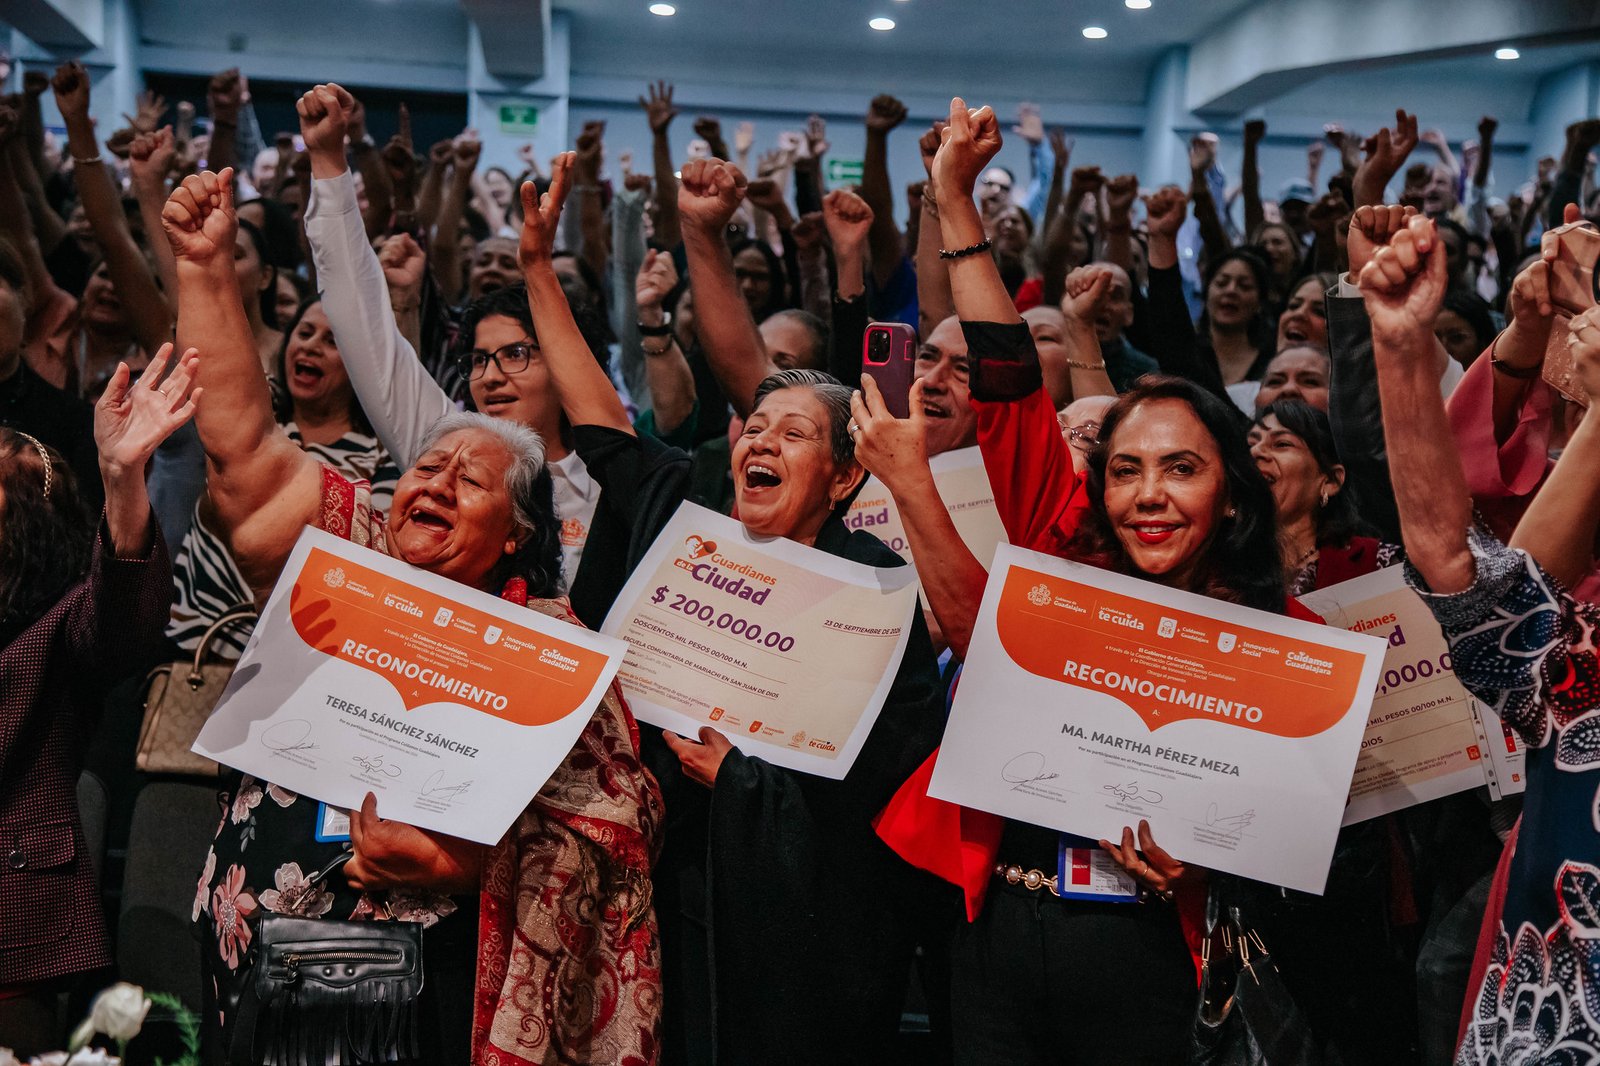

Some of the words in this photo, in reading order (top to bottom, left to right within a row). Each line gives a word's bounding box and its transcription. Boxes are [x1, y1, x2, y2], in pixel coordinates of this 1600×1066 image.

[851, 498, 886, 510] dianes
[845, 508, 888, 529] dad
[712, 554, 776, 585] Guardianes
[692, 564, 771, 605] Ciudad
[383, 596, 395, 606] te
[395, 599, 425, 617] cuida
[1053, 600, 1086, 613] Guadalajara
[651, 585, 670, 604] $
[669, 594, 794, 652] 200,000.00
[1098, 611, 1109, 621] te
[1111, 613, 1144, 630] cuida
[1348, 613, 1397, 632] rdianes
[844, 624, 880, 634] SEPTIEMBRE
[1180, 632, 1208, 644] Guadalajara
[1182, 626, 1205, 636] Cuidamos
[502, 641, 520, 651] Social
[506, 635, 536, 650] Innovación
[633, 618, 675, 638] DOSCIENTOS
[675, 633, 687, 644] MIL
[688, 640, 711, 653] PESOS
[711, 649, 733, 662] 00/100
[733, 659, 748, 669] M.N.
[1241, 647, 1261, 657] Social
[1243, 641, 1279, 654] Innovación
[541, 647, 580, 666] Cuidamos
[1144, 649, 1166, 658] Gobierno
[1287, 651, 1332, 668] Cuidamos
[537, 655, 576, 673] Guadalajara
[623, 635, 646, 648] ESCUELA
[647, 644, 684, 663] COMUNITARIA
[693, 662, 721, 678] MARIACHI
[729, 678, 742, 686] SAN
[742, 682, 758, 692] JUAN
[765, 691, 779, 699] DIOS
[1135, 652, 1165, 664] Coordinación
[1166, 660, 1183, 668] General
[1184, 665, 1207, 674] Cuidamos
[1208, 671, 1235, 682] Guadalajara
[1140, 659, 1160, 668] Dirección
[1167, 666, 1192, 676] Innovación
[1285, 659, 1331, 676] Guadalajara
[1375, 653, 1453, 694] ,000.0
[342, 639, 508, 711] RECONOCIMIENTO
[1064, 660, 1262, 724] RECONOCIMIENTO
[1370, 717, 1384, 726] MIL
[1385, 708, 1410, 720] PESOS
[1411, 701, 1436, 712] 00/100
[1437, 696, 1454, 704] M.N.
[325, 695, 367, 719] TERESA
[369, 713, 424, 739] SÁNCHEZ
[424, 734, 479, 758] SÁNCHEZ
[816, 742, 836, 751] cuida
[1062, 724, 1088, 738] MA.
[1091, 731, 1152, 754] MARTHA
[1156, 745, 1197, 765] PÉREZ
[1200, 758, 1240, 776] MEZA
[1361, 736, 1384, 748] DIOS
[1092, 749, 1120, 760] participación
[1131, 759, 1152, 768] Programa
[1153, 764, 1174, 774] Cuidamos
